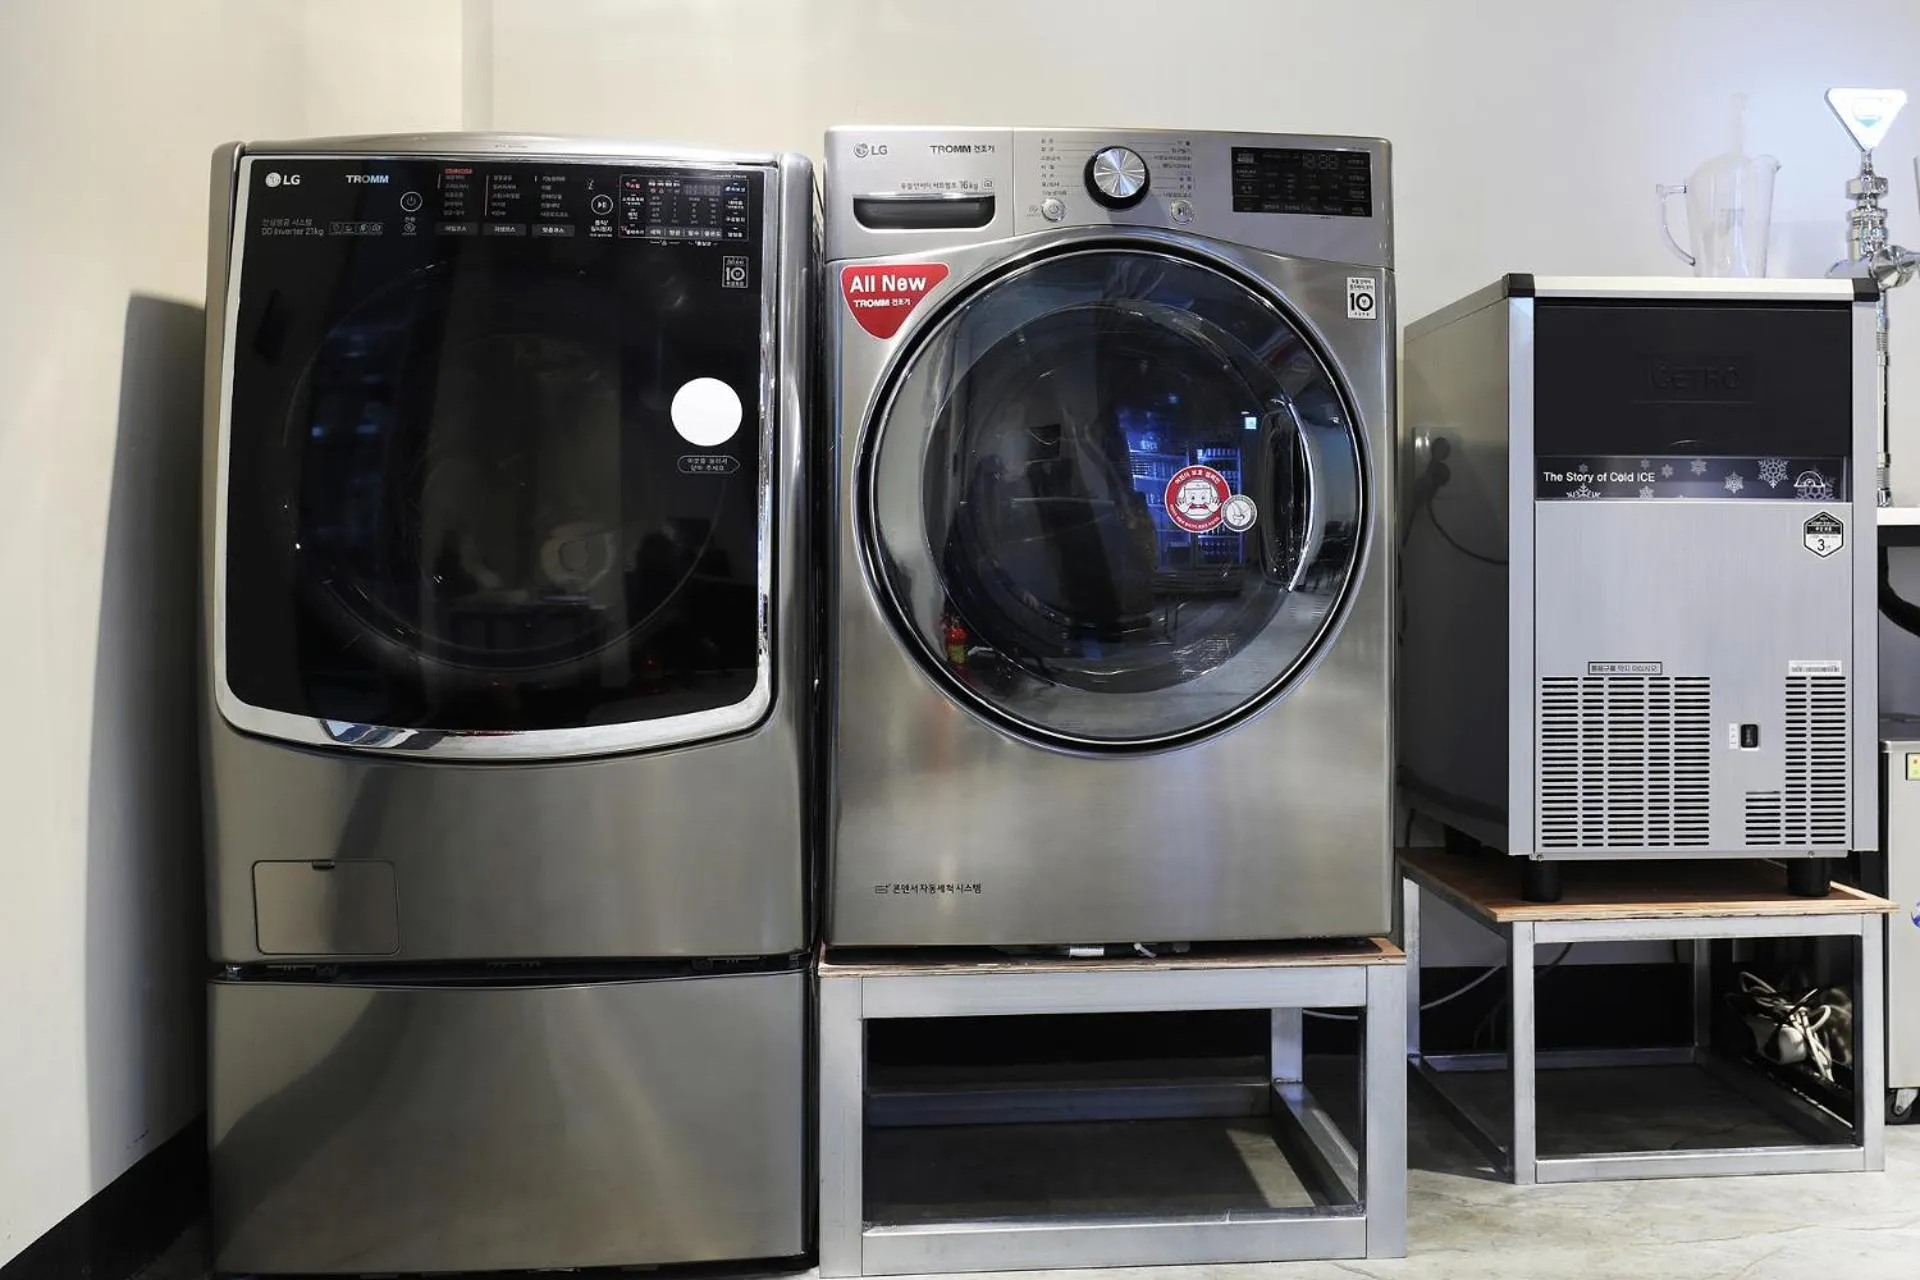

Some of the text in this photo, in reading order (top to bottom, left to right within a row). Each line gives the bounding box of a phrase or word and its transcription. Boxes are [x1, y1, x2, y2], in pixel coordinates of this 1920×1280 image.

[869, 144, 888, 156] LG
[929, 144, 995, 155] TROMM 건조기
[282, 174, 301, 186] LG
[345, 174, 390, 184] TROMM
[849, 274, 927, 293] All New
[853, 298, 890, 308] TROMM
[1544, 471, 1656, 484] The Story of Cold ICE
[1817, 538, 1825, 552] 3
